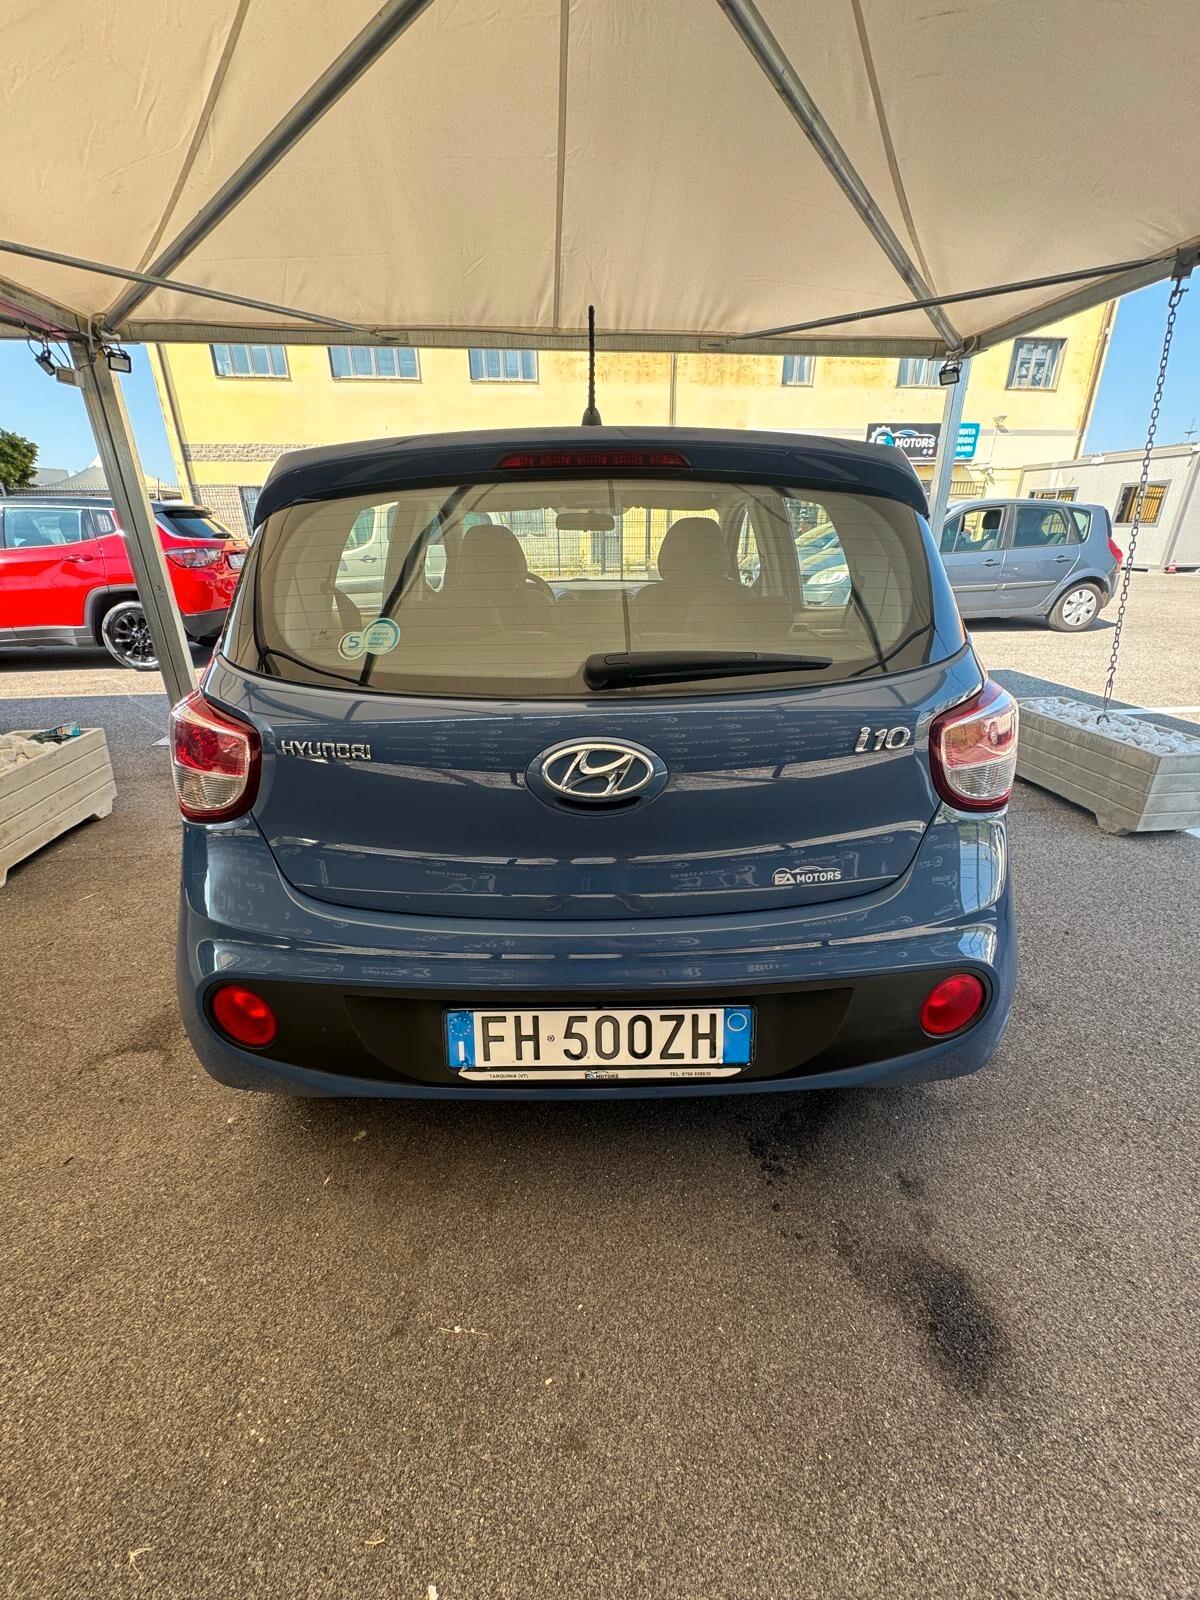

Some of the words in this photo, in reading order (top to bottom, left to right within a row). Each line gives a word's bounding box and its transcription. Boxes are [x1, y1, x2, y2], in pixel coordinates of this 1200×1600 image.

[895, 438, 936, 448] MOTORS
[348, 636, 360, 648] 5
[854, 726, 911, 753] i10
[280, 740, 372, 760] HYUNDAI
[774, 873, 796, 886] EA
[796, 870, 842, 883] MOTORS
[481, 1014, 540, 1062] FH
[563, 1013, 717, 1062] 500ZH
[458, 1041, 465, 1061] I
